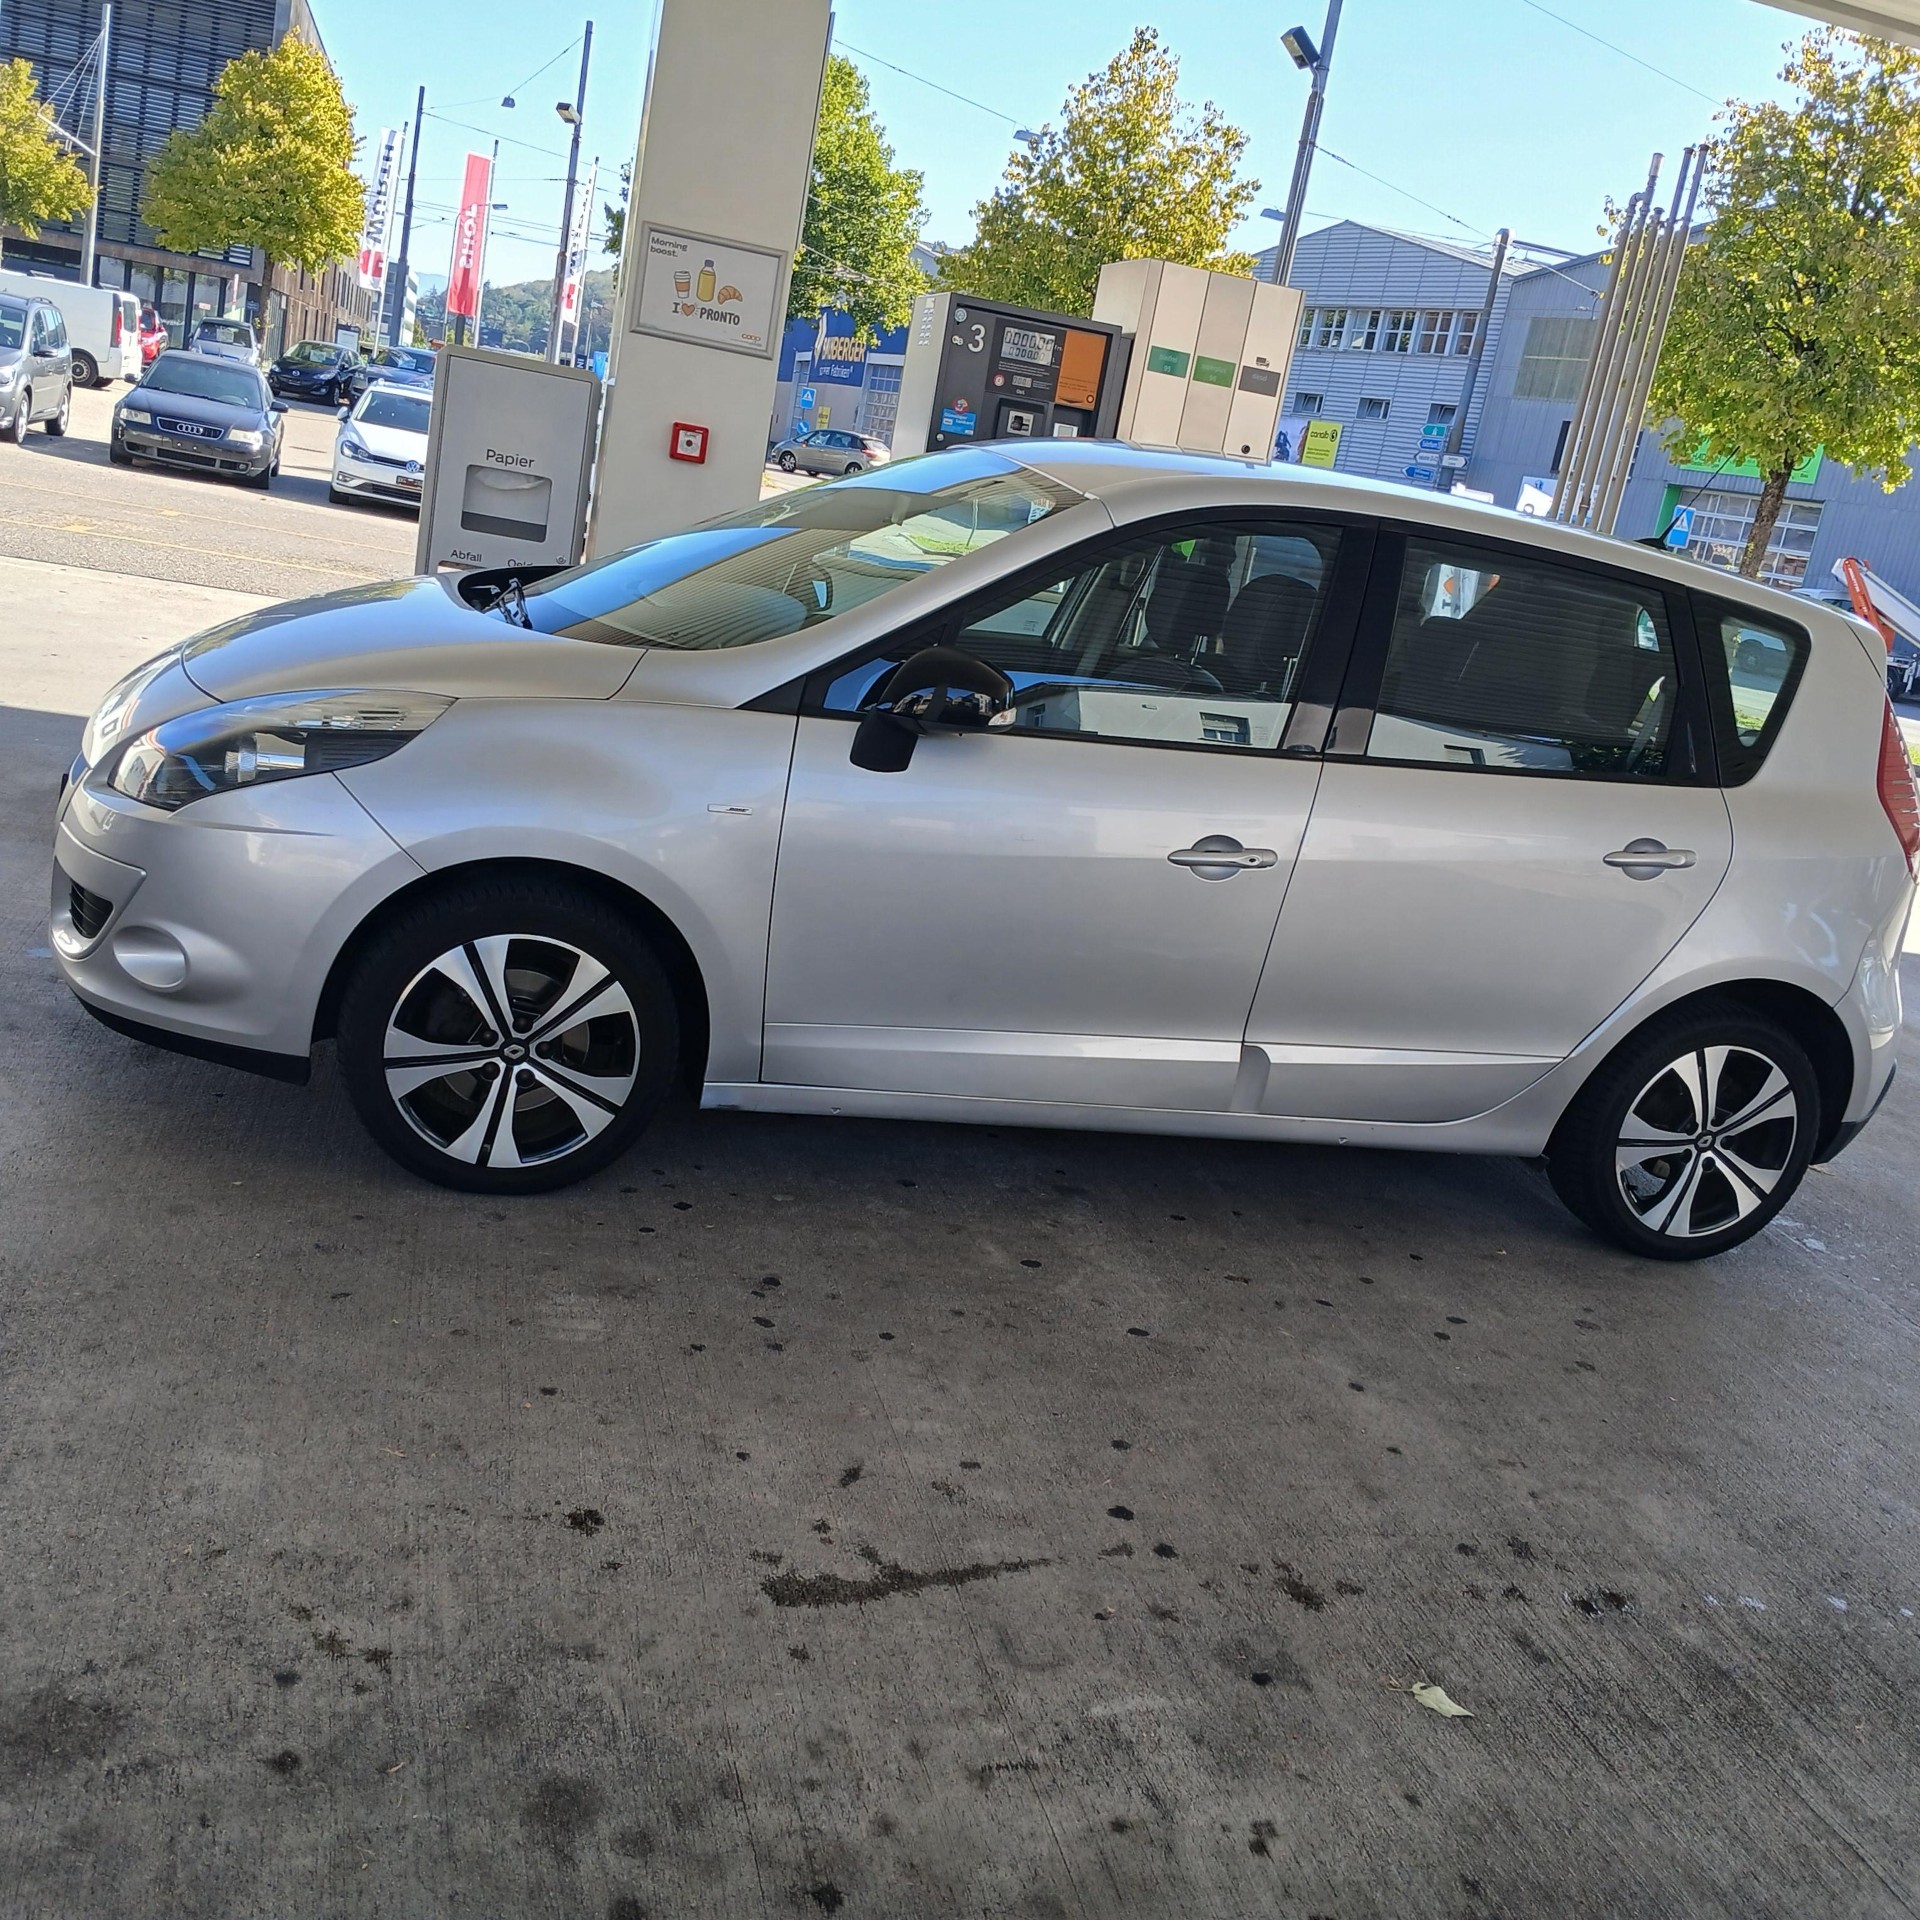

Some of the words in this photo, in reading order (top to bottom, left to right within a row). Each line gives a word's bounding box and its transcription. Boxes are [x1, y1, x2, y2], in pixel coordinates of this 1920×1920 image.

[650, 245, 678, 258] boost.
[651, 236, 689, 252] Morning
[672, 302, 681, 314] I
[699, 307, 741, 326] PRONTO
[967, 324, 986, 352] 3
[486, 448, 536, 469] Papier
[450, 548, 483, 563] Abfall
